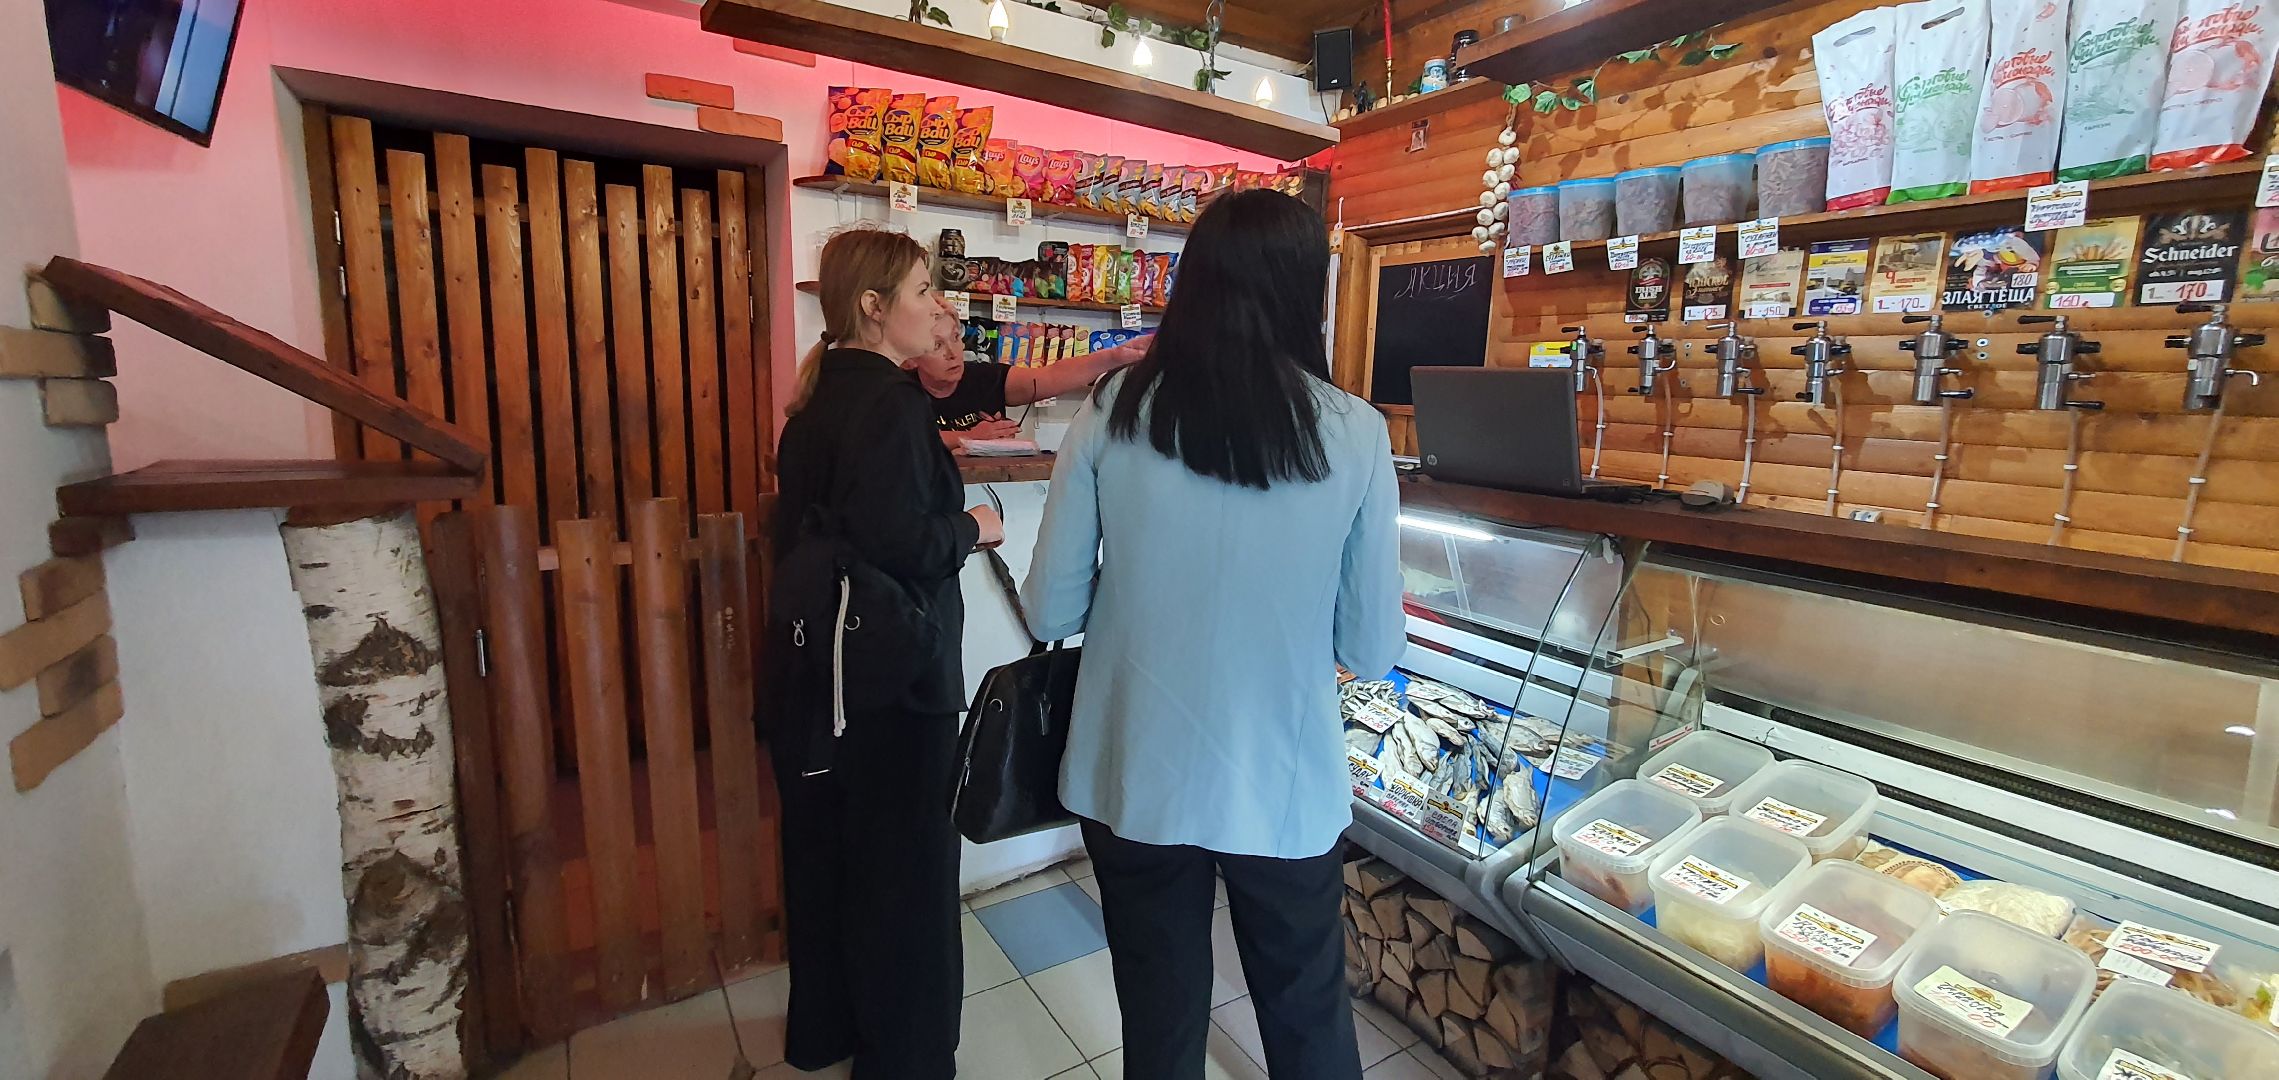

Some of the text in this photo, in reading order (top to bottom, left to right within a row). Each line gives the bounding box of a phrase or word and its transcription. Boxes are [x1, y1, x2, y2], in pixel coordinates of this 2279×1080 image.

[2142, 243, 2239, 264] Schneider
[1394, 263, 1478, 298] АКЦИЯ
[2012, 274, 2032, 286] 180
[1941, 290, 1983, 305] ЗЛАЯ
